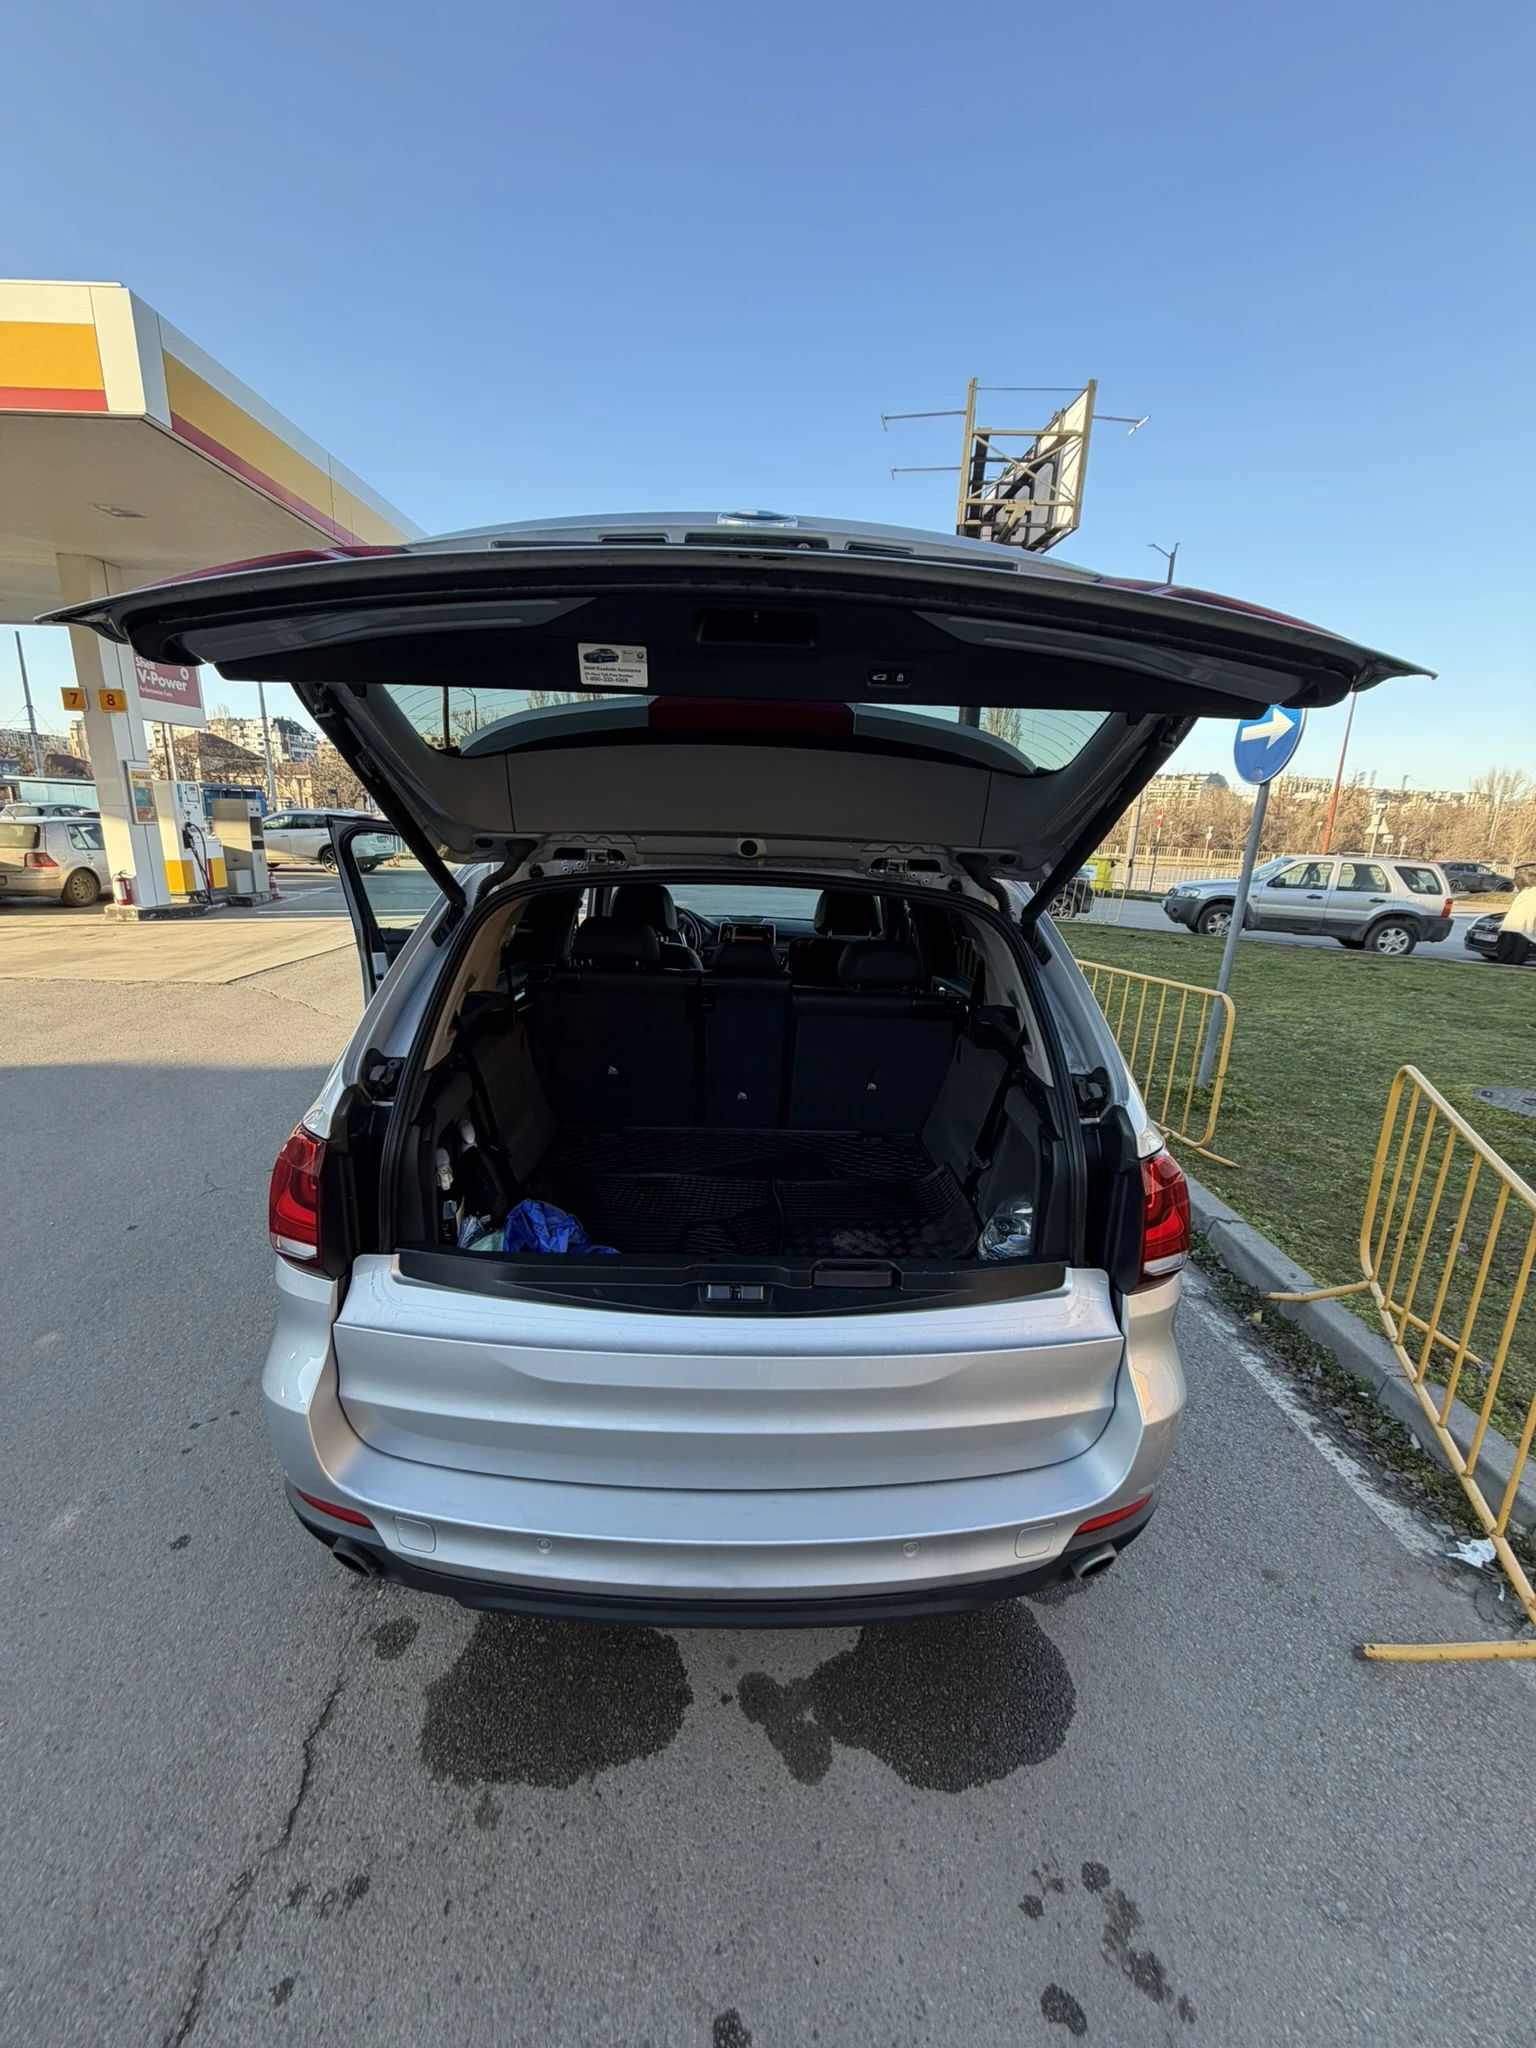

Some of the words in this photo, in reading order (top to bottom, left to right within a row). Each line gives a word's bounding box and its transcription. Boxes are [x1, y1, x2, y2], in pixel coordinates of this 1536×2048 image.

[135, 656, 155, 670] Shell
[137, 669, 187, 691] V-Power
[139, 685, 163, 696] Performance
[69, 692, 79, 705] 7
[106, 694, 116, 706] 8
